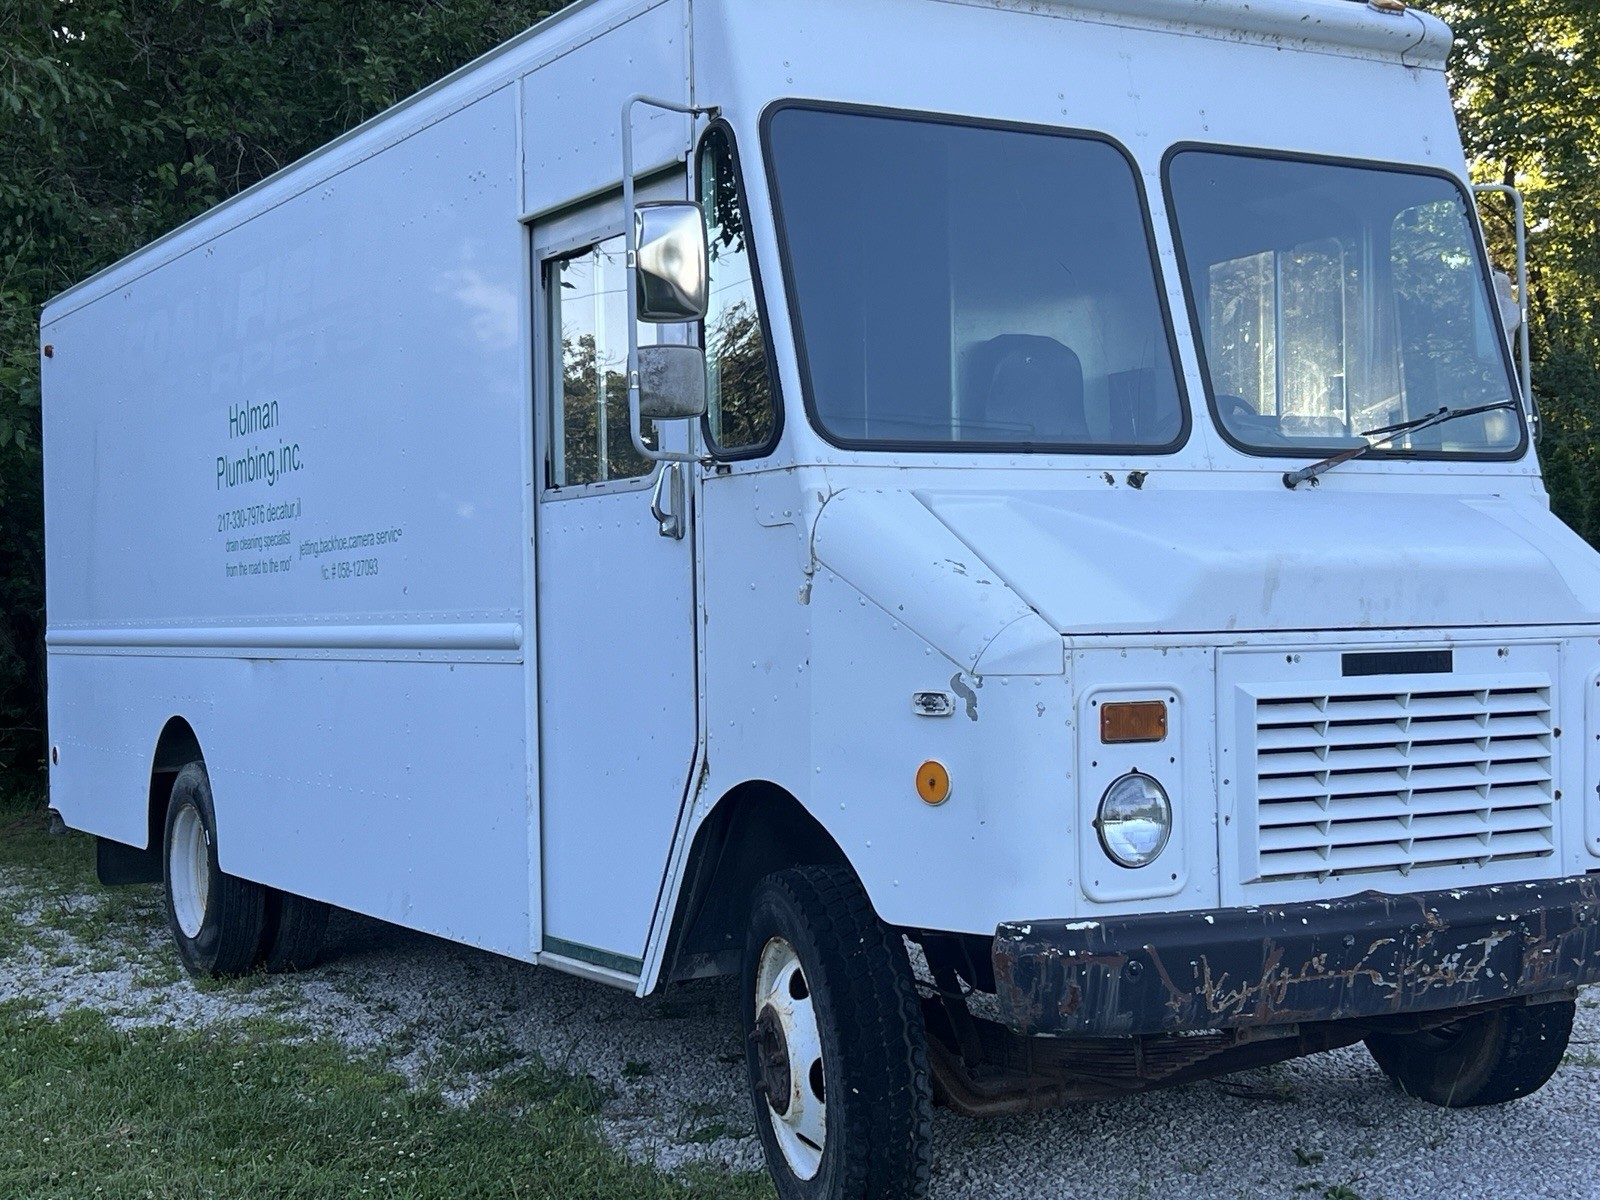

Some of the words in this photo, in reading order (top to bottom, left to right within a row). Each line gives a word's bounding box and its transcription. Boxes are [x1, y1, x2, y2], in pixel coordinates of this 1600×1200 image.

[229, 399, 279, 439] Holman
[216, 438, 304, 491] Plumbing,inc.
[217, 504, 265, 532] 217-330-7976
[225, 537, 239, 552] drain
[239, 533, 262, 552] cleaning
[263, 530, 291, 551] specialist
[226, 562, 238, 577] from
[239, 561, 248, 576] the
[248, 559, 262, 575] road
[262, 559, 269, 573] to
[269, 557, 279, 573] the
